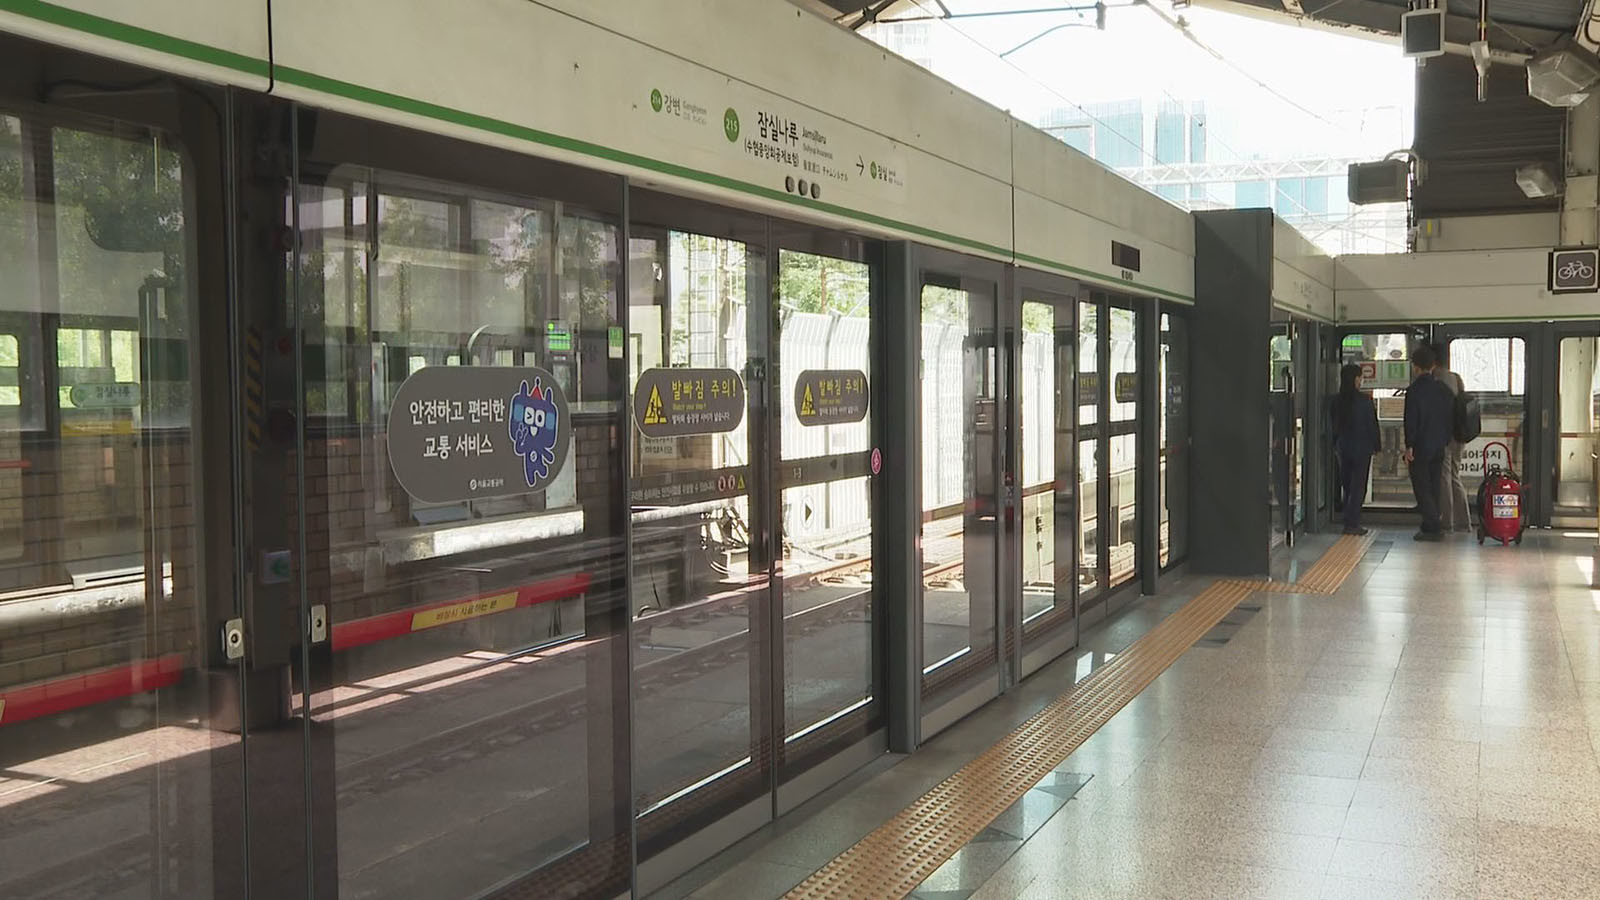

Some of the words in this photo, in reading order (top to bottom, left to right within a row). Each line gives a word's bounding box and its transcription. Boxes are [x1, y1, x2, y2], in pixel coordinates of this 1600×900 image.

[664, 94, 681, 117] 강변
[726, 118, 738, 133] 215
[757, 111, 799, 147] 잠실나루
[671, 380, 704, 401] 발빠짐
[711, 379, 736, 399] 주의!
[819, 378, 841, 397] 발빠짐
[410, 399, 464, 425] 안전하고
[468, 398, 505, 423] 편리한
[423, 435, 451, 460] 교통
[456, 433, 493, 457] 서비스
